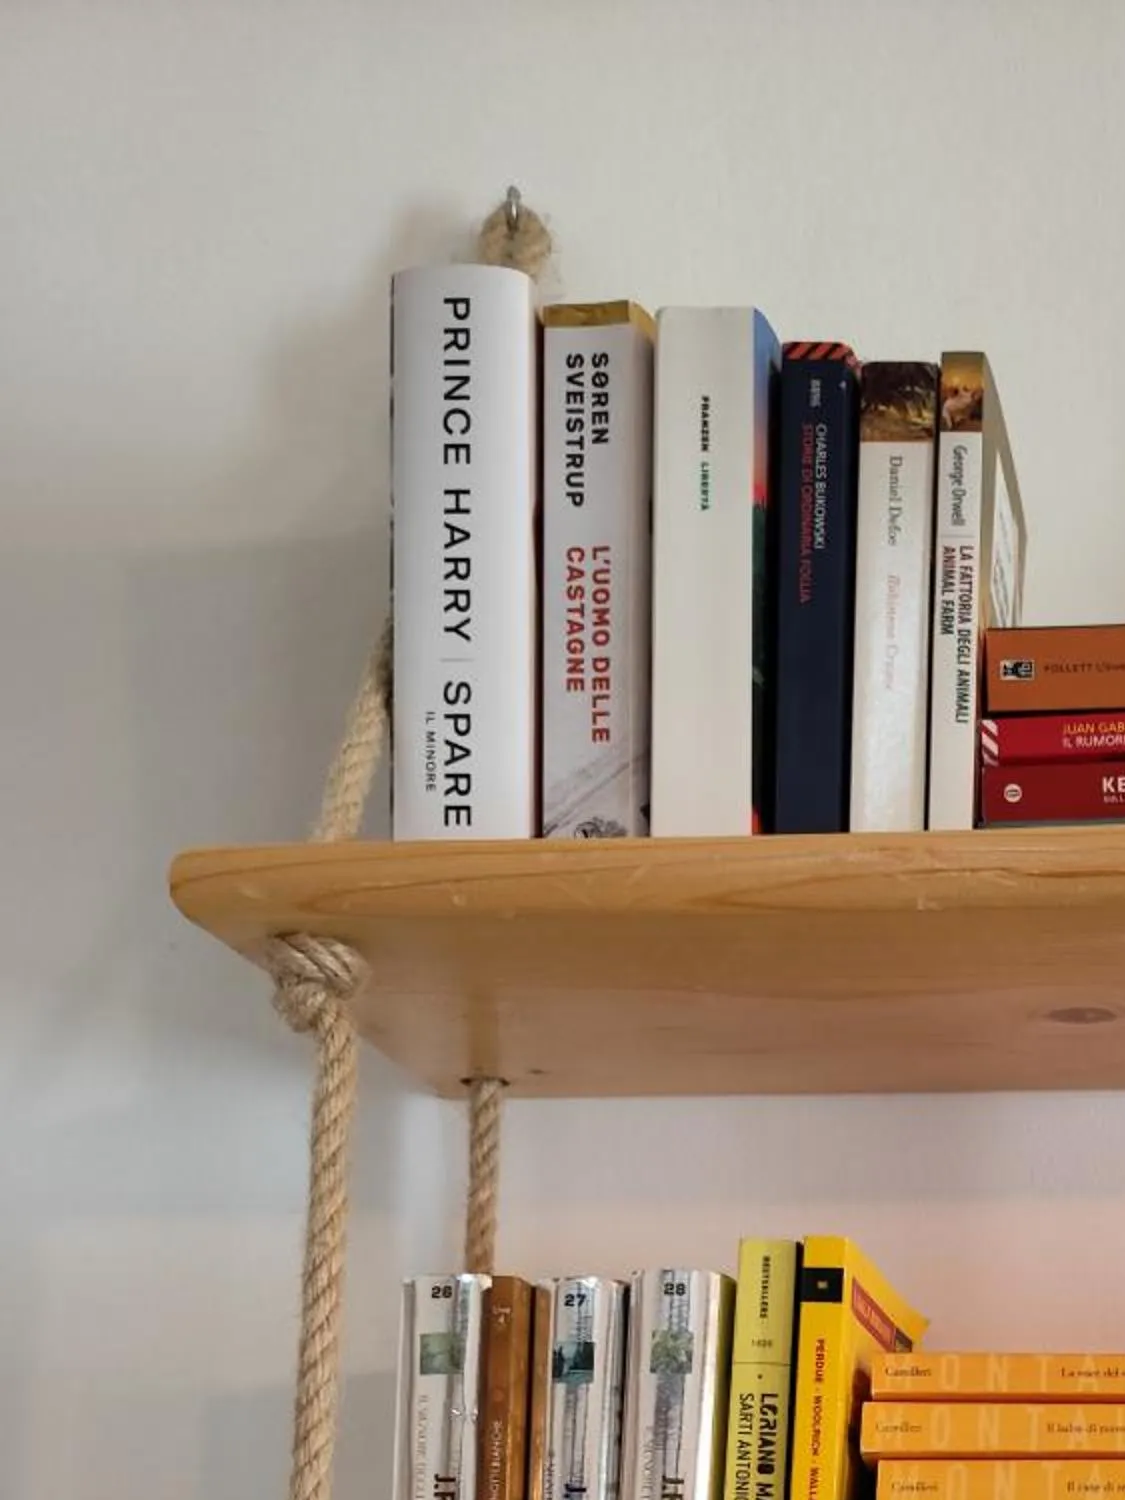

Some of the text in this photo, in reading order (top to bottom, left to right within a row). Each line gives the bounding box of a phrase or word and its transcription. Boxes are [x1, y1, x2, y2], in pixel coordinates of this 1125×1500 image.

[565, 352, 585, 508] SVEISTRUP
[591, 352, 609, 445] SØREN
[443, 296, 471, 643] PRINCE HARRY
[815, 422, 827, 478] CHARLES
[888, 454, 903, 505] Daniel
[949, 444, 968, 527] George Orwell
[814, 481, 826, 550] BUKOWSKI
[565, 545, 585, 693] CASTAGNE
[940, 545, 957, 636] ANIMAL FARM
[592, 545, 611, 743] L'UOMO DELLE
[954, 545, 974, 724] LA FATTORIA DEGLI ANIMALI
[425, 711, 437, 793] IL MINORE
[443, 679, 472, 827] SPARE
[1063, 722, 1096, 735] JUAN
[1063, 736, 1073, 748] IL
[564, 1293, 587, 1307] 27
[663, 1281, 686, 1296] 28
[814, 1338, 826, 1383] PERDUE
[737, 1392, 755, 1436] SARTI
[756, 1392, 779, 1475] LORIANO
[811, 1395, 823, 1456] WOOLRICH
